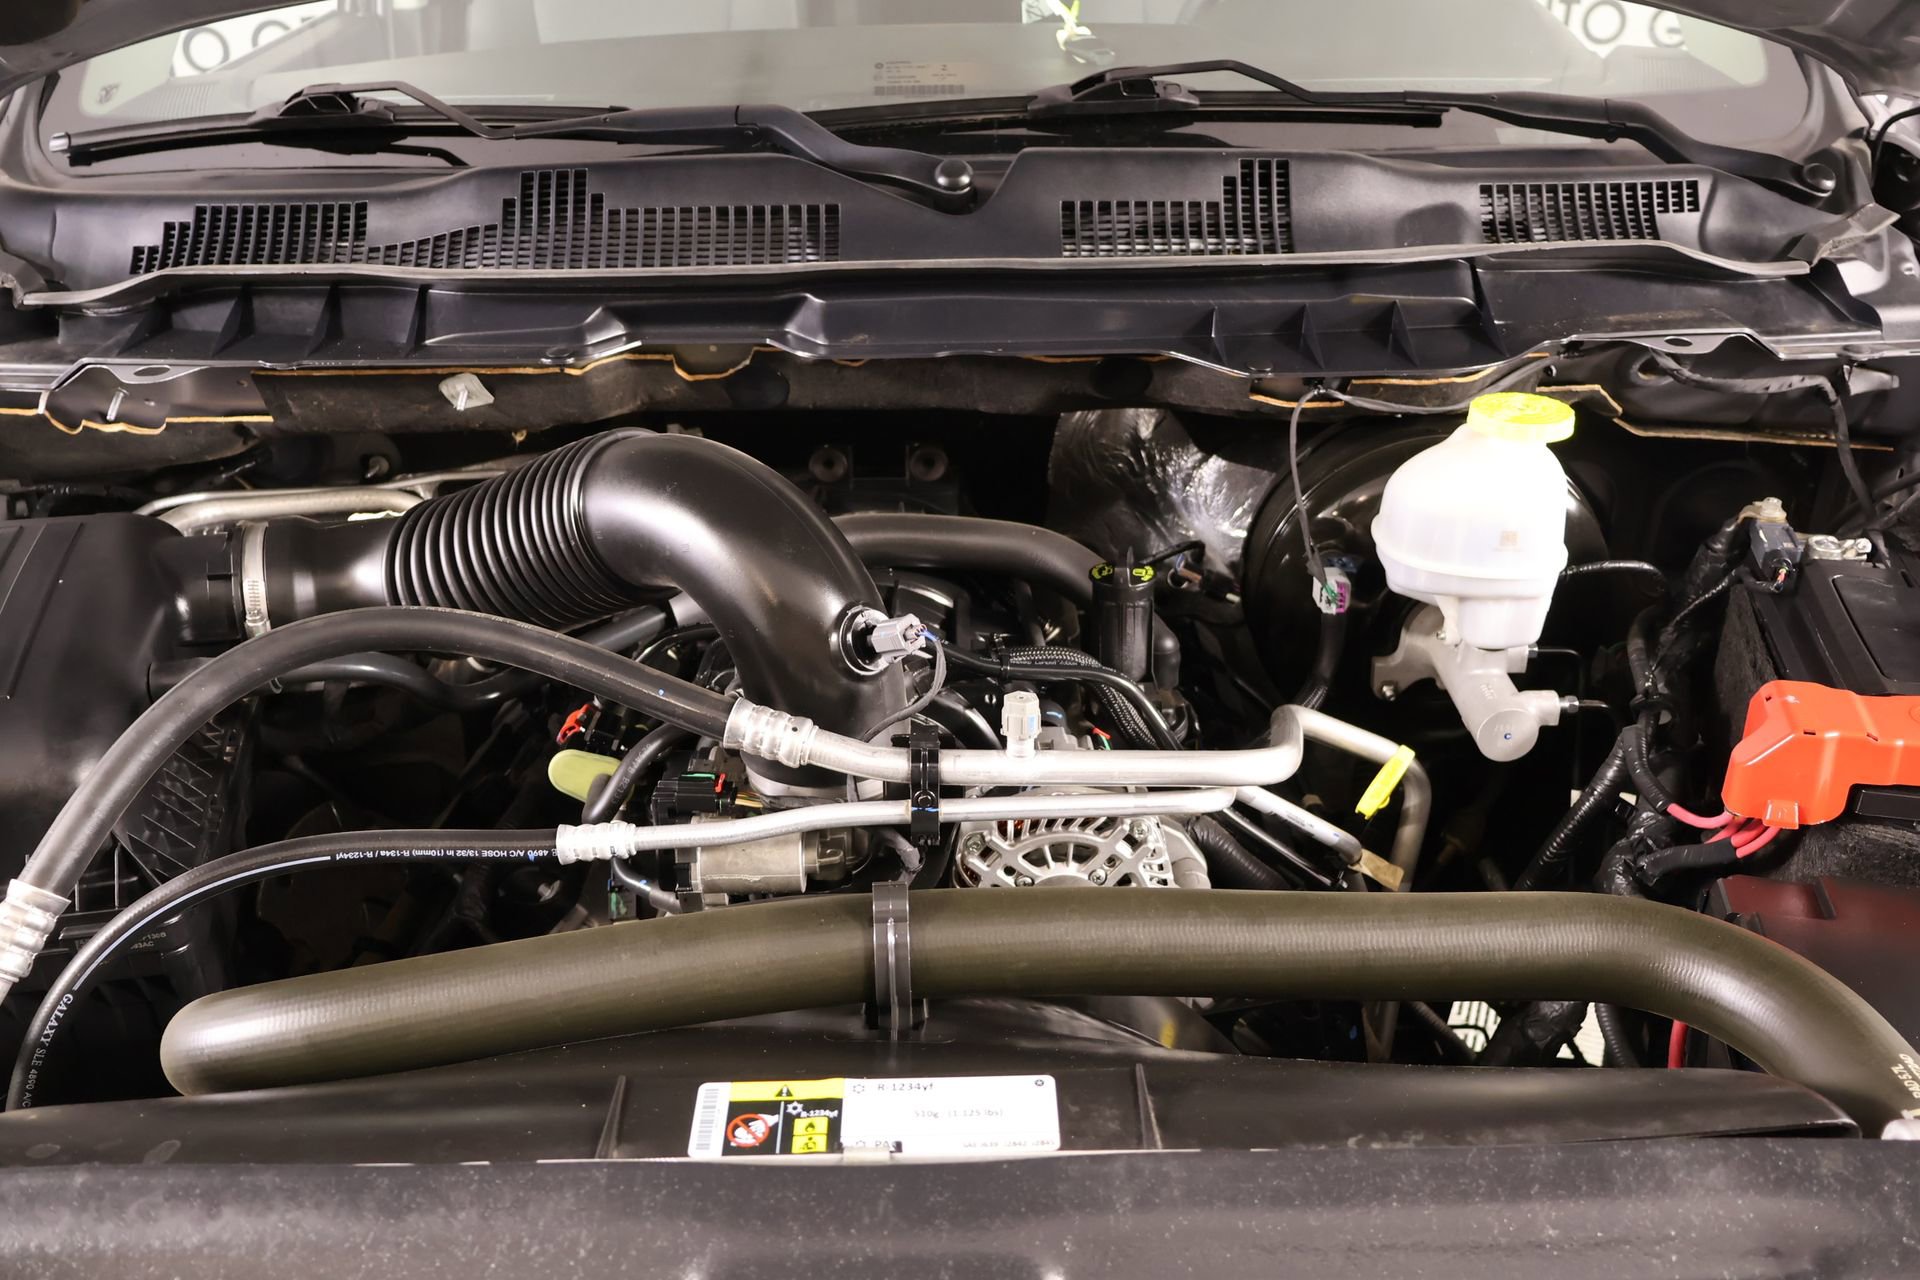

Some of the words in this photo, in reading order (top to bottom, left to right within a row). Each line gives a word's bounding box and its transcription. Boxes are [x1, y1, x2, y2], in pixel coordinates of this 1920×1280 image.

[335, 850, 374, 861] R-1234yf
[380, 849, 410, 857] R-134a
[412, 848, 444, 858] (10mm)
[456, 849, 479, 857] 13/32
[481, 850, 507, 858] HOSE
[509, 849, 525, 857] A/C
[527, 849, 549, 857] 4890
[40, 993, 74, 1047] GALAXY
[31, 1047, 47, 1067] SLE
